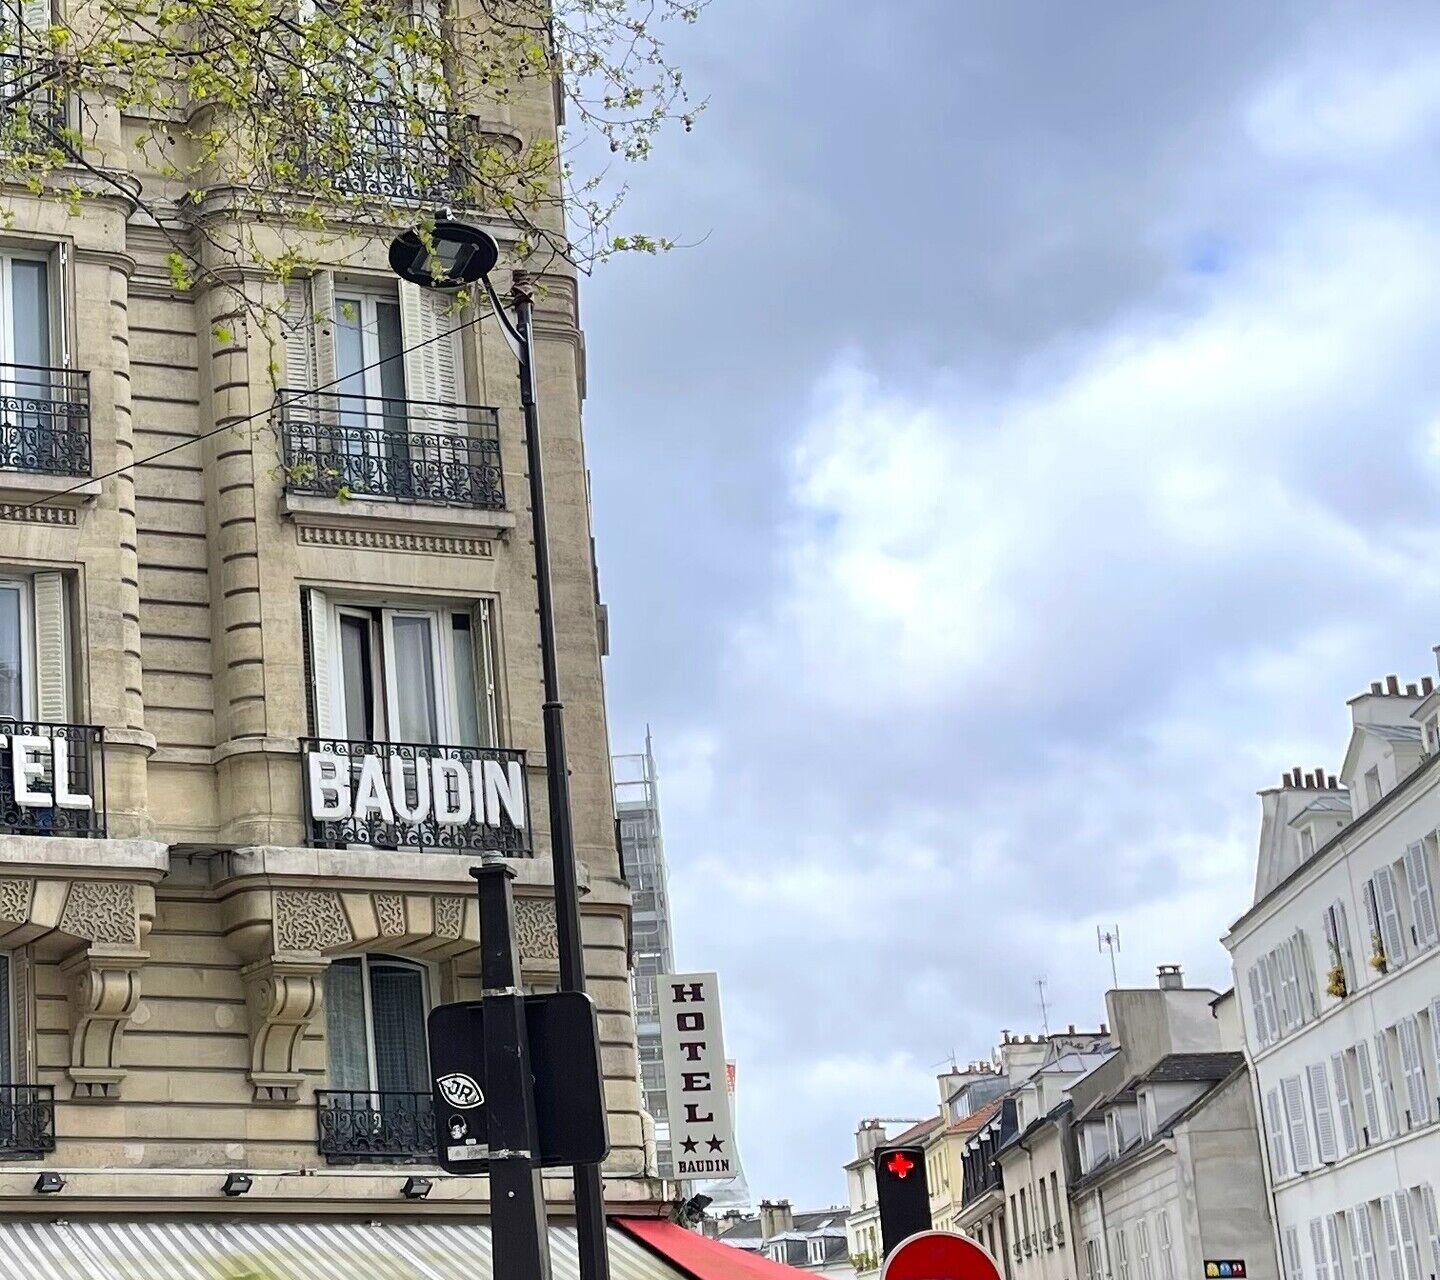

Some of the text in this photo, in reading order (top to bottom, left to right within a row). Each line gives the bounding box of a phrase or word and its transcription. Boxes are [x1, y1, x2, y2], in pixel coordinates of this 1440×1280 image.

[309, 751, 525, 829] BAUDIN
[671, 983, 714, 1124] HOTEL
[447, 1080, 473, 1102] JR
[678, 1159, 729, 1173] BAUDIN
